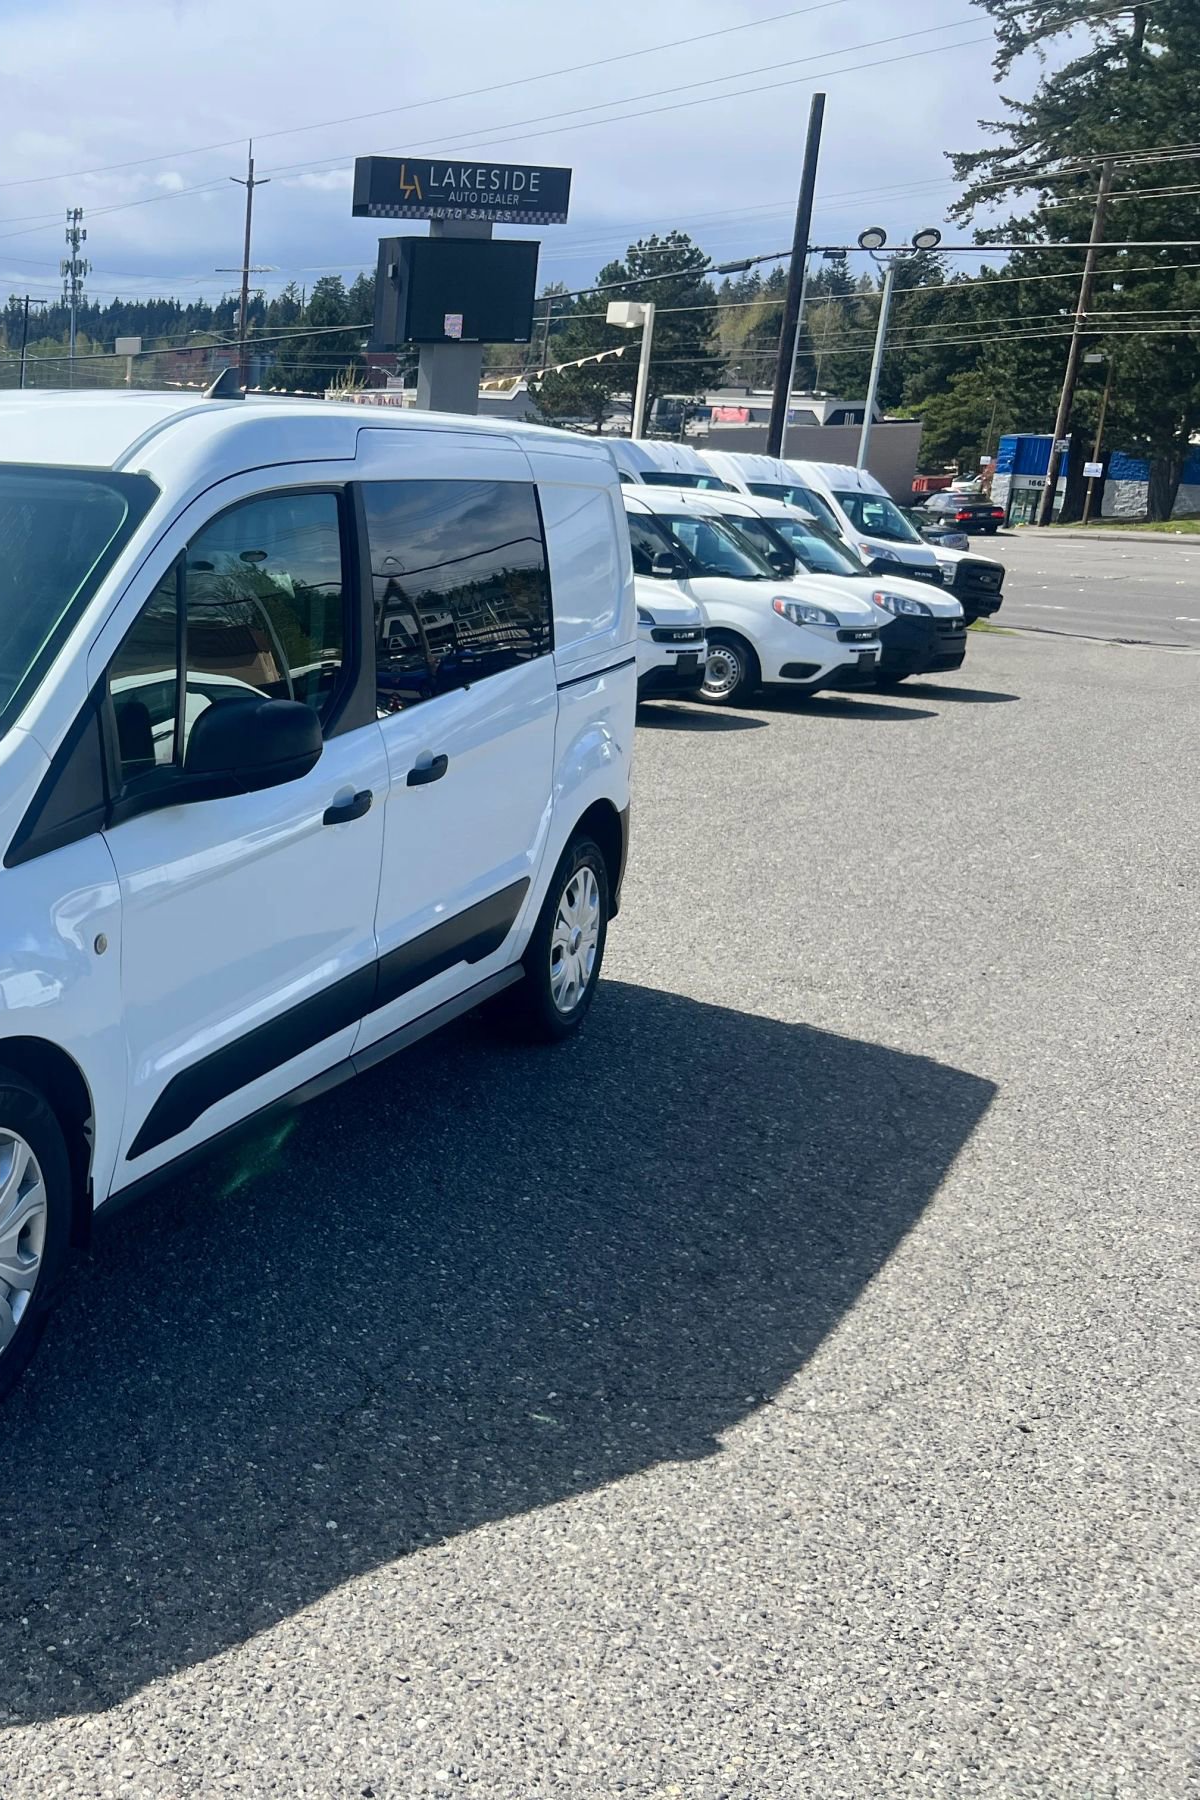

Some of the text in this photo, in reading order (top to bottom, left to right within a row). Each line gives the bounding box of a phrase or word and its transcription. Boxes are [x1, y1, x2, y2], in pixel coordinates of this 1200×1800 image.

[429, 166, 541, 192] LAKESIDE
[448, 191, 519, 205] AUTO DEALER
[427, 209, 511, 221] AUTO SALES
